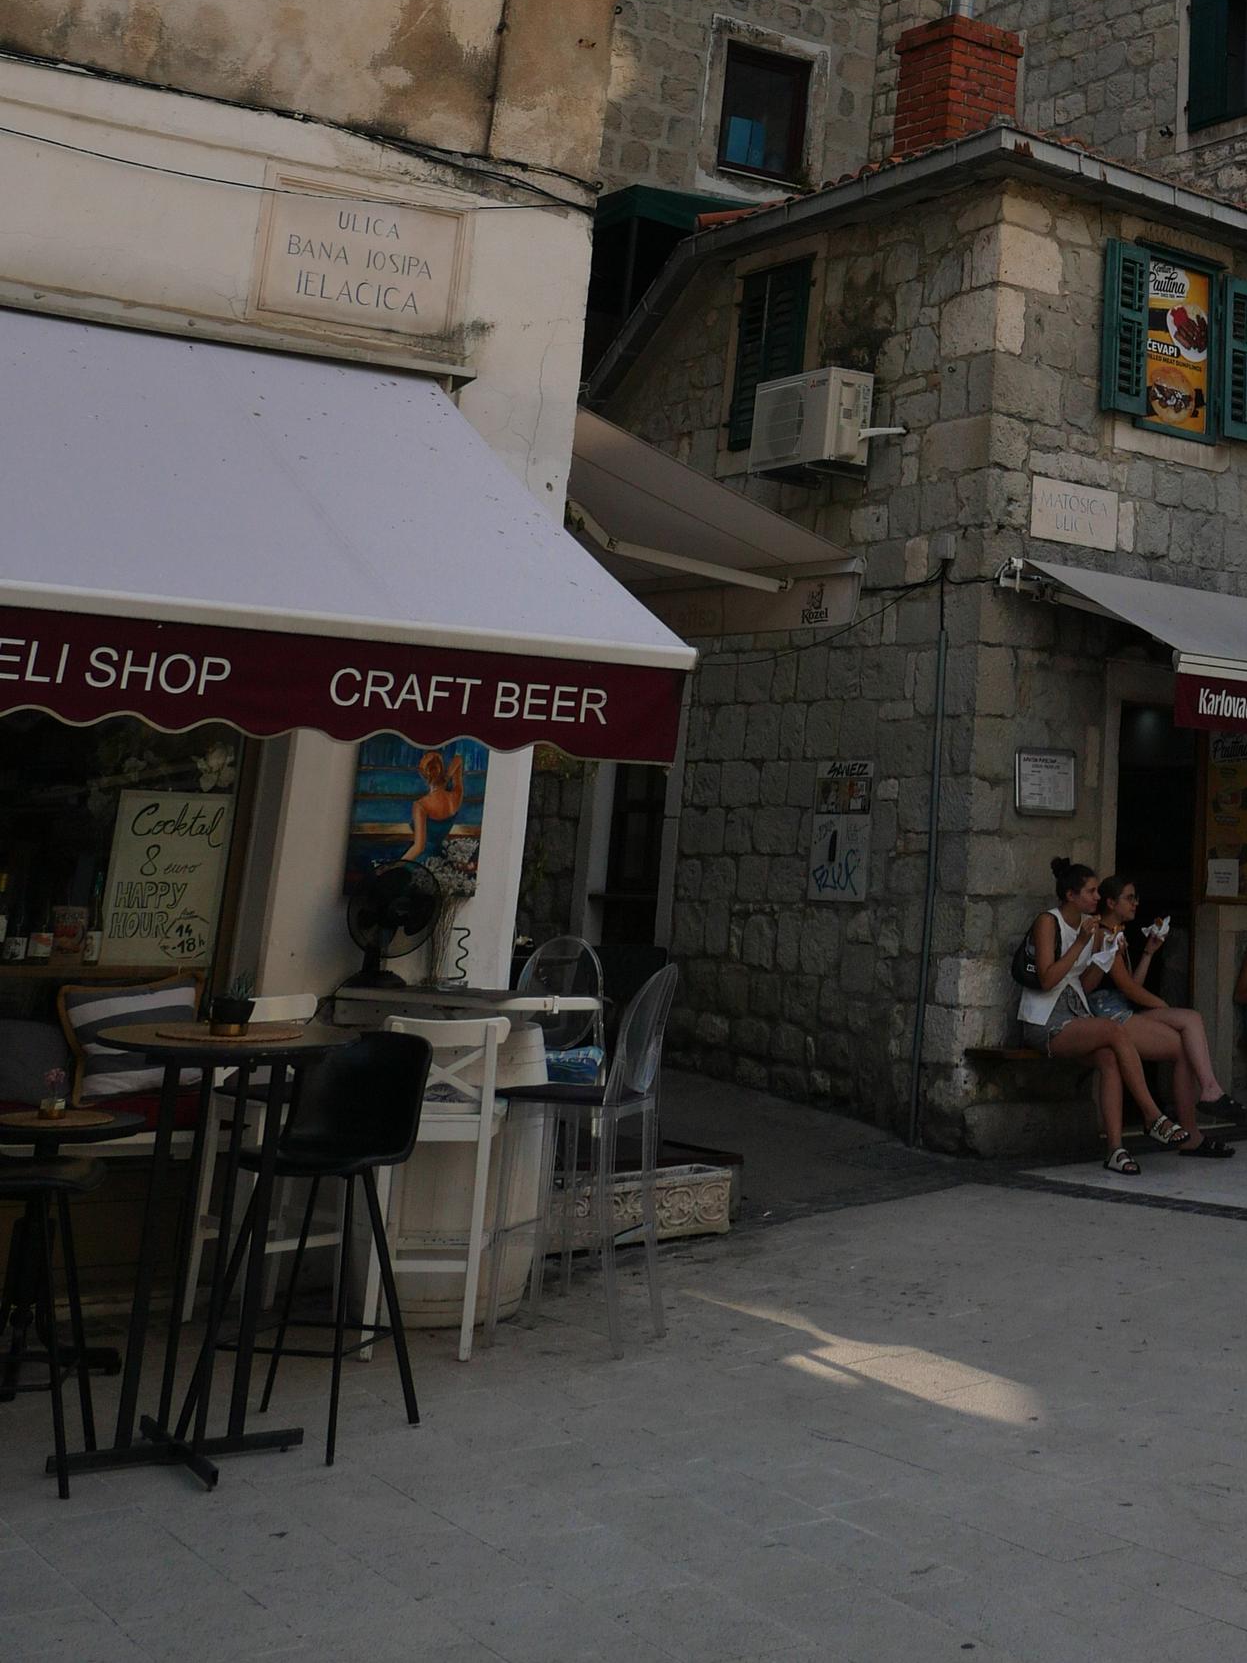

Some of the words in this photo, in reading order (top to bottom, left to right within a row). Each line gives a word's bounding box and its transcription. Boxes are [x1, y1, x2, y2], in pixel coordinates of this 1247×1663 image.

[338, 210, 400, 240] ULICA
[287, 234, 349, 266] BANA
[801, 607, 829, 625] Kozel
[84, 646, 232, 696] SHOP
[329, 667, 482, 715] CRAFT
[493, 681, 608, 725] BEER
[131, 802, 225, 848] Cocktail
[140, 844, 161, 876] 8
[163, 862, 202, 875] euro
[114, 881, 188, 909] HAPPY
[108, 911, 171, 939] HOUR
[175, 923, 193, 937] 14
